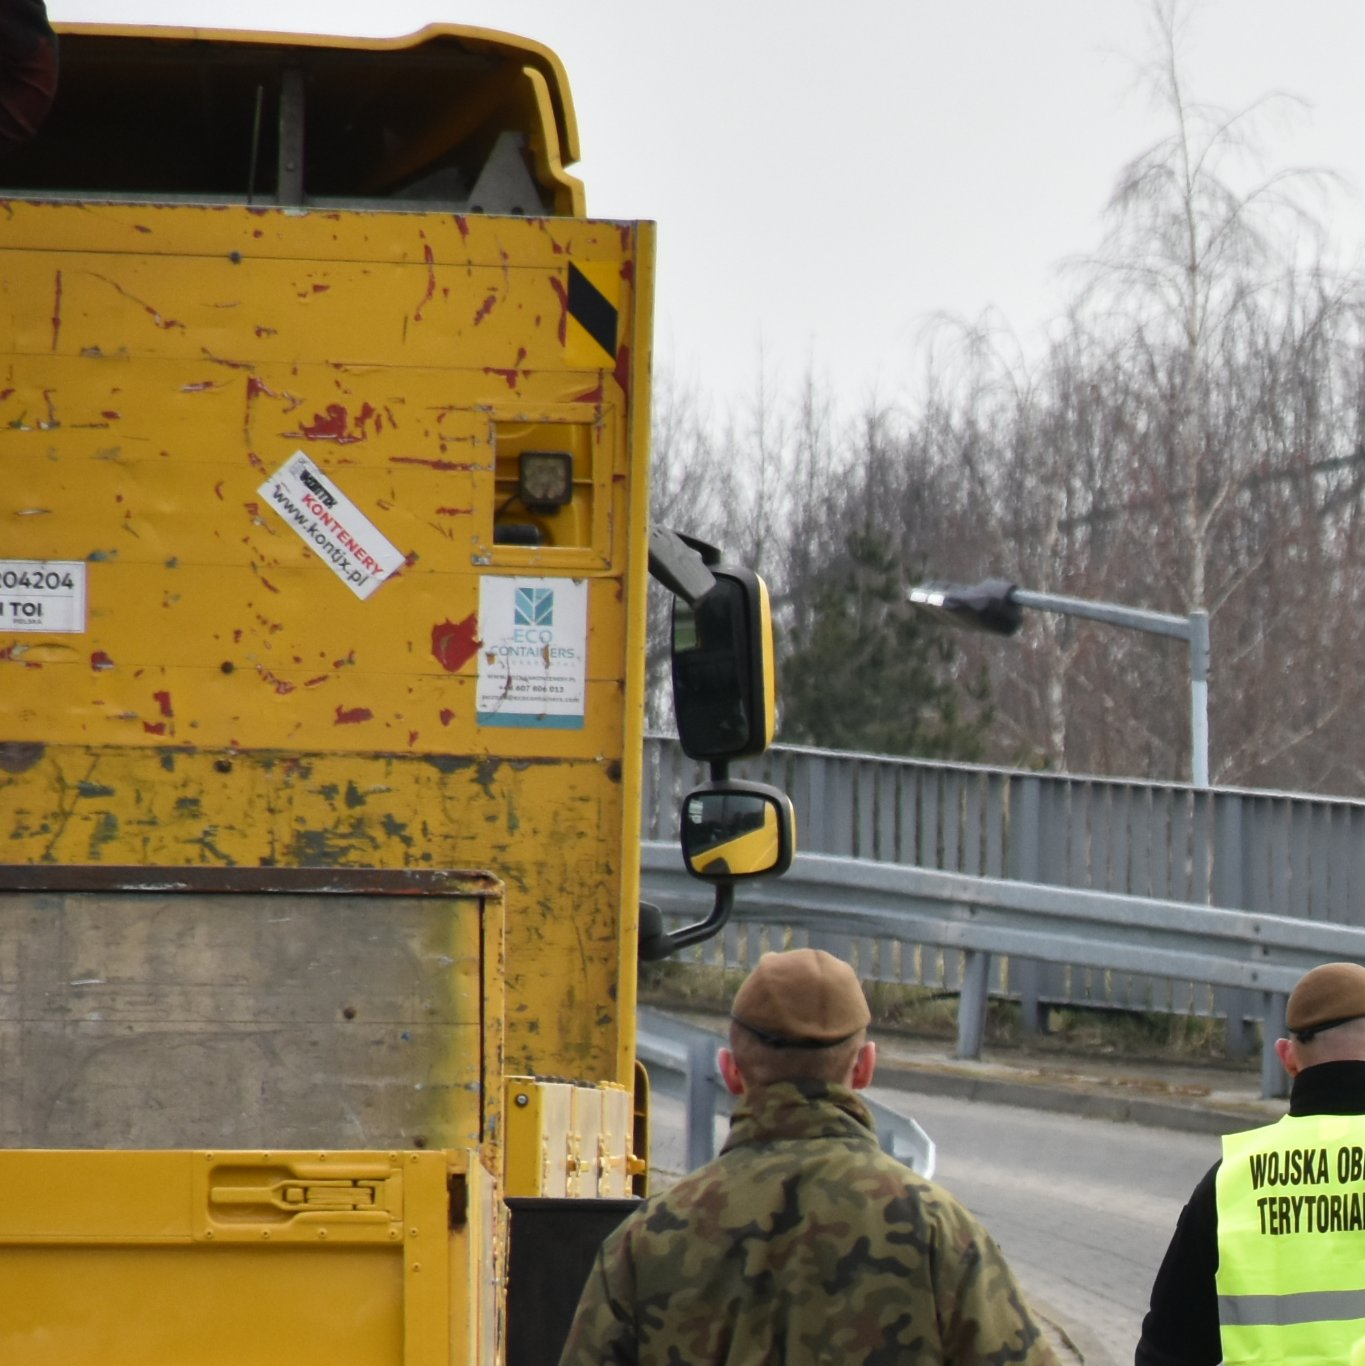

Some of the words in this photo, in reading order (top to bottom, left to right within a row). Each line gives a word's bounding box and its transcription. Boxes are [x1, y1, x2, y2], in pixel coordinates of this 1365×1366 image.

[302, 493, 384, 577] KONTENERY
[9, 602, 43, 617] TOI
[513, 629, 553, 644] ECO
[490, 645, 575, 658] CONTAIERS
[1249, 1148, 1329, 1191] WOJSKA
